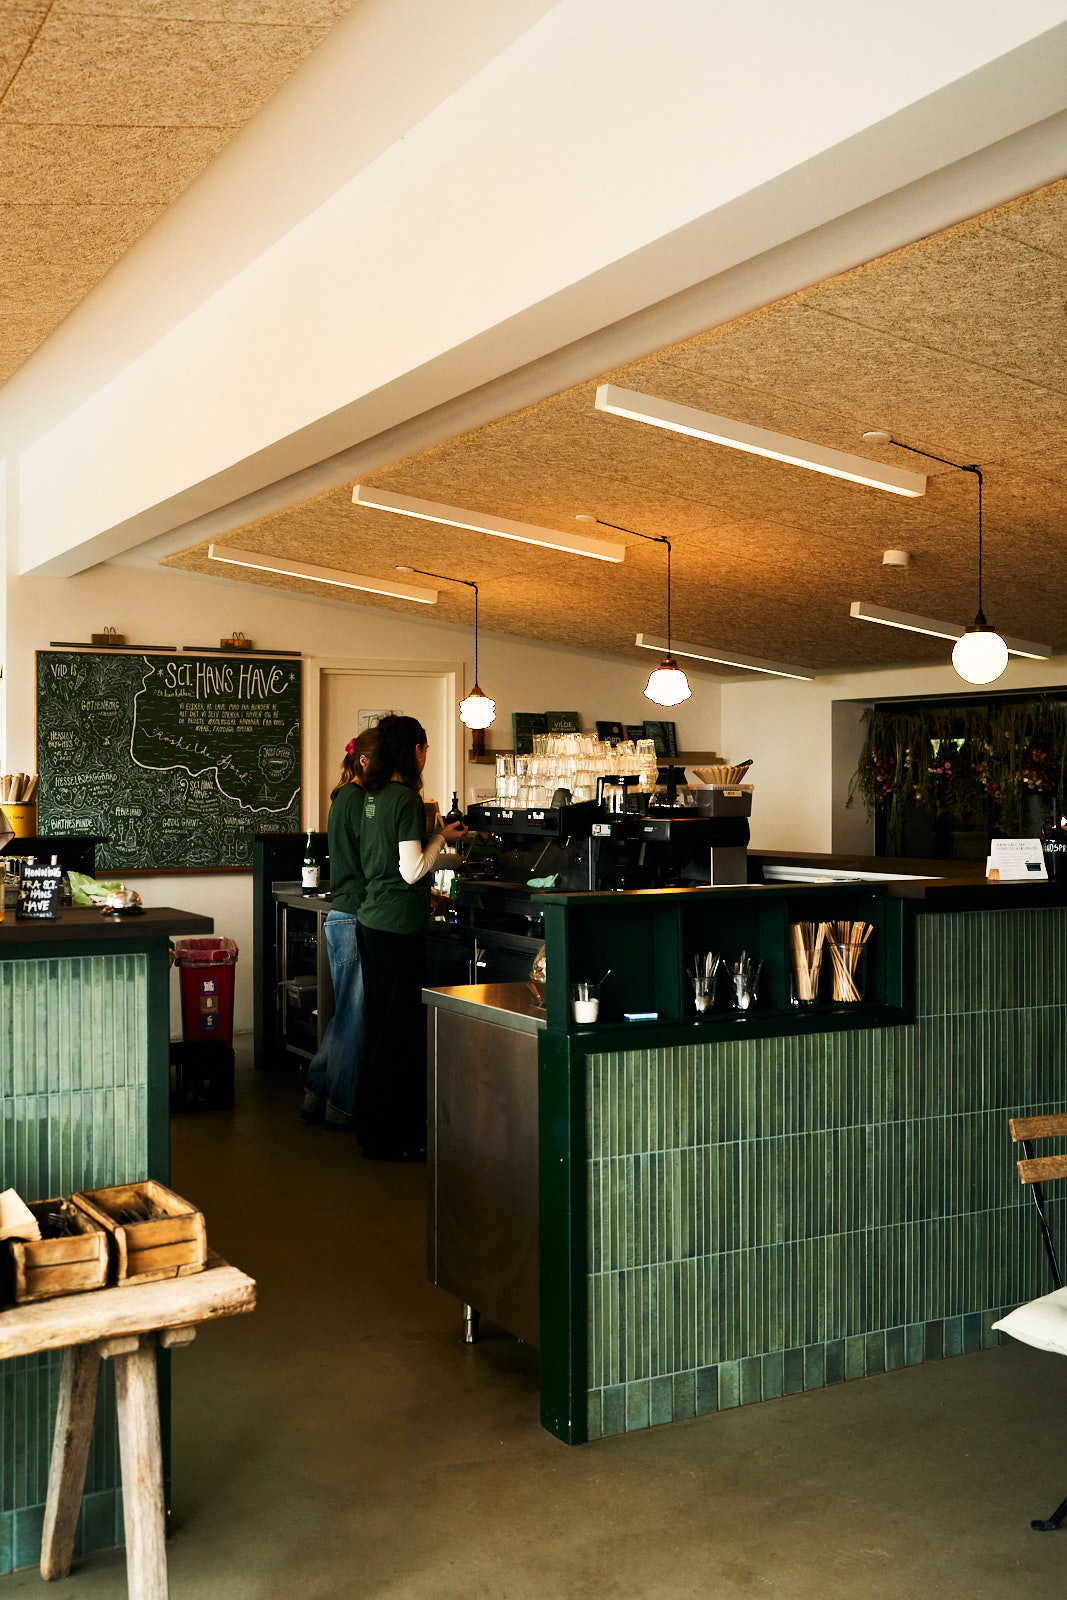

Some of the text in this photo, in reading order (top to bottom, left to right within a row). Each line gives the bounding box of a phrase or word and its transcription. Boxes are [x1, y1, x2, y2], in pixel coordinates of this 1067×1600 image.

[196, 661, 234, 699] HANS
[238, 663, 289, 700] HAVE
[30, 889, 52, 900] HANS
[22, 900, 51, 913] HAVE
